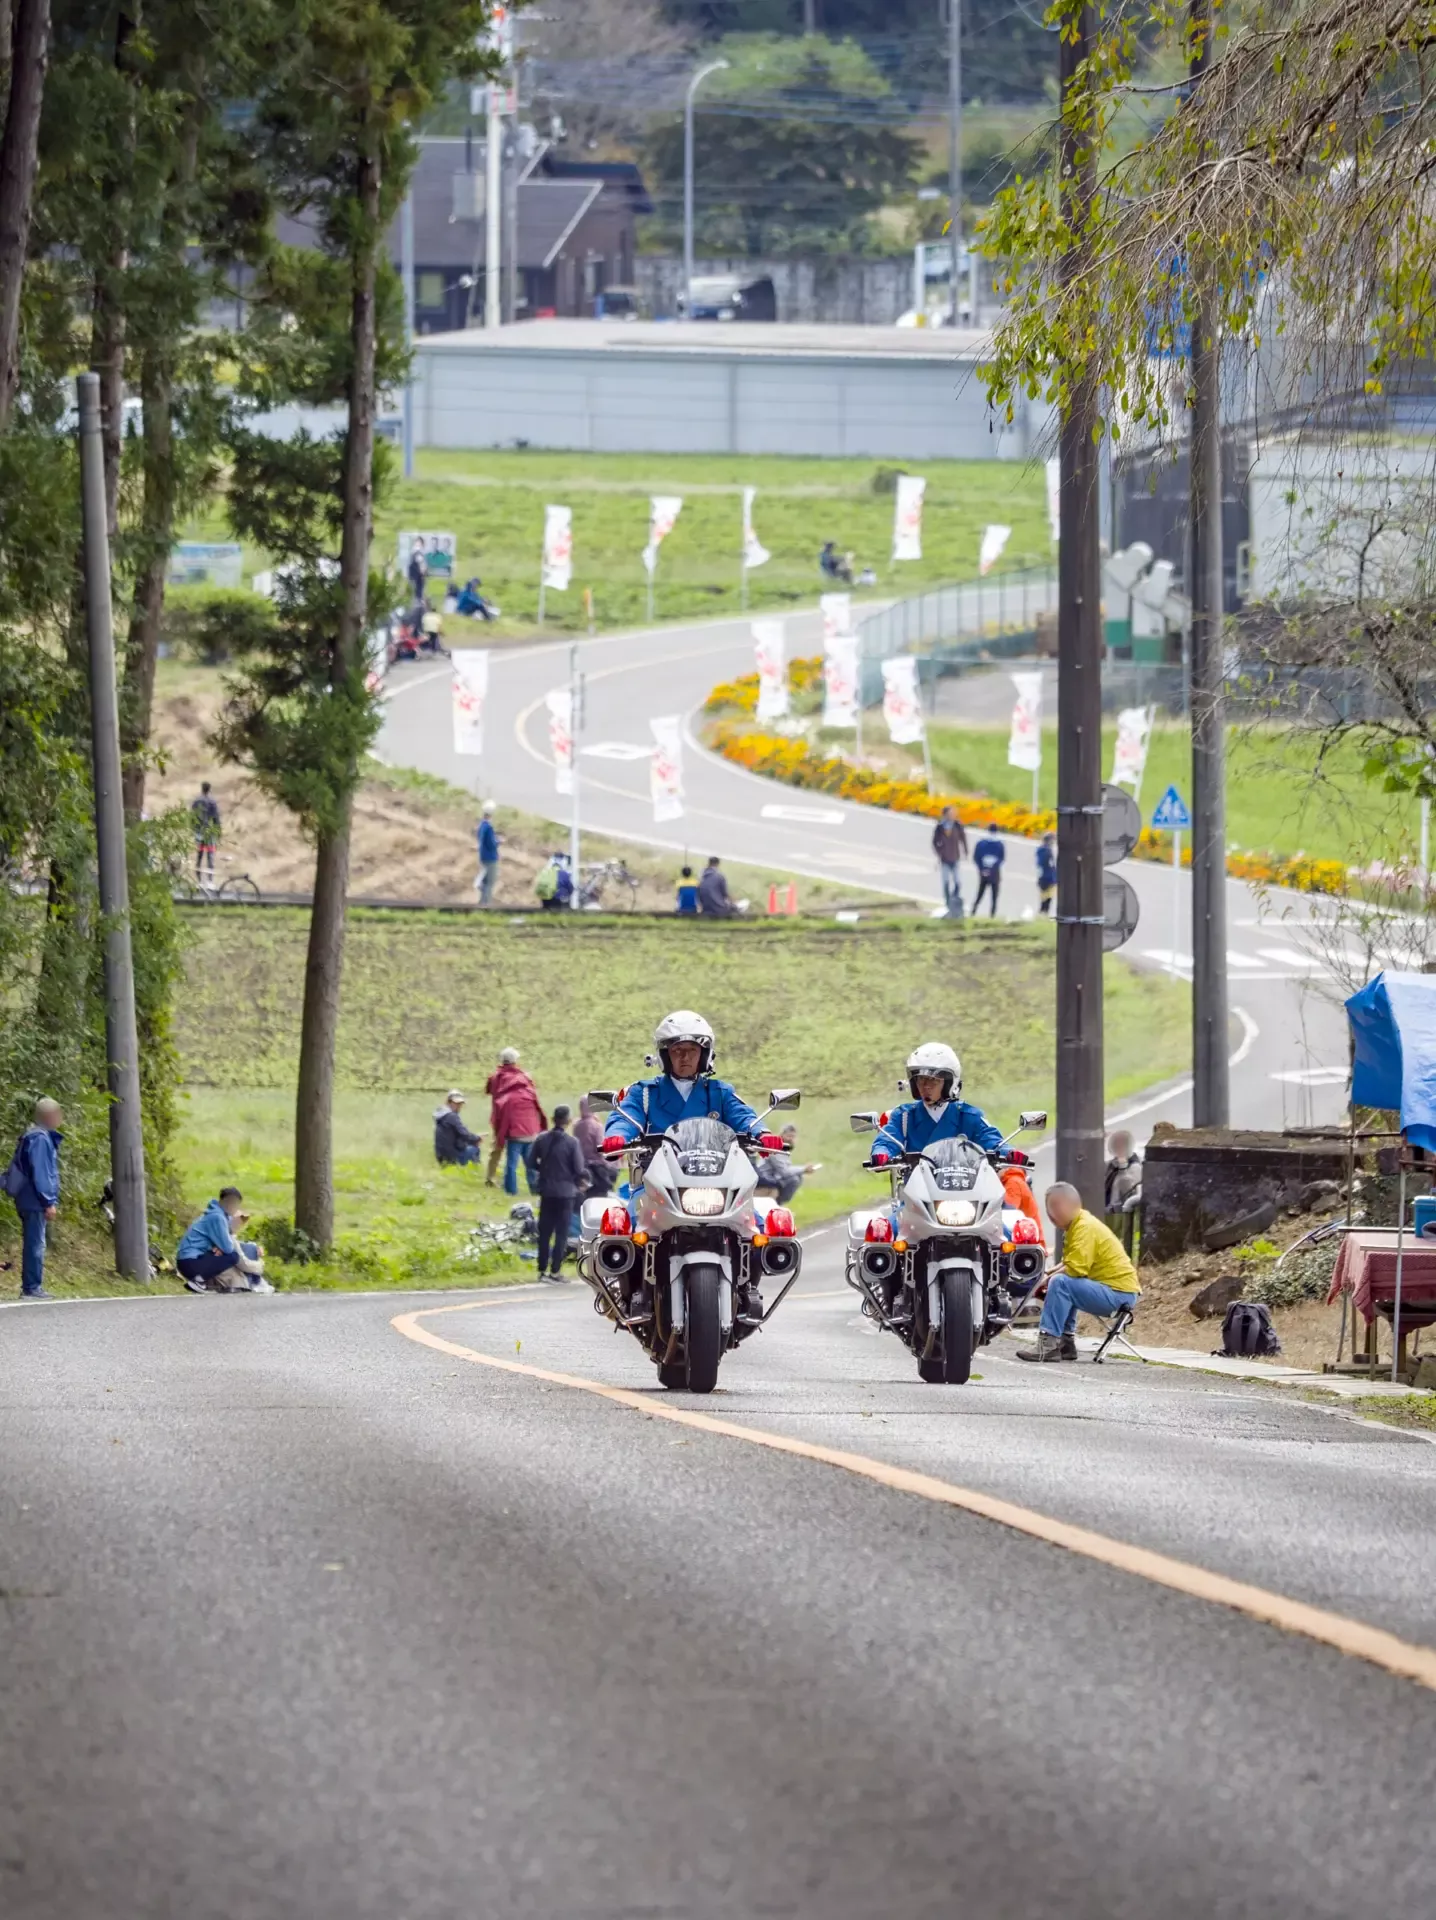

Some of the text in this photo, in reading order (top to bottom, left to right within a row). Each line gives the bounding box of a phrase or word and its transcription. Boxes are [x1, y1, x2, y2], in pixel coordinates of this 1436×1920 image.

[677, 1149, 726, 1159] POLICE
[688, 1163, 717, 1173] とちぎ
[933, 1166, 976, 1175] POLICE
[942, 1178, 970, 1188] とちぎ
